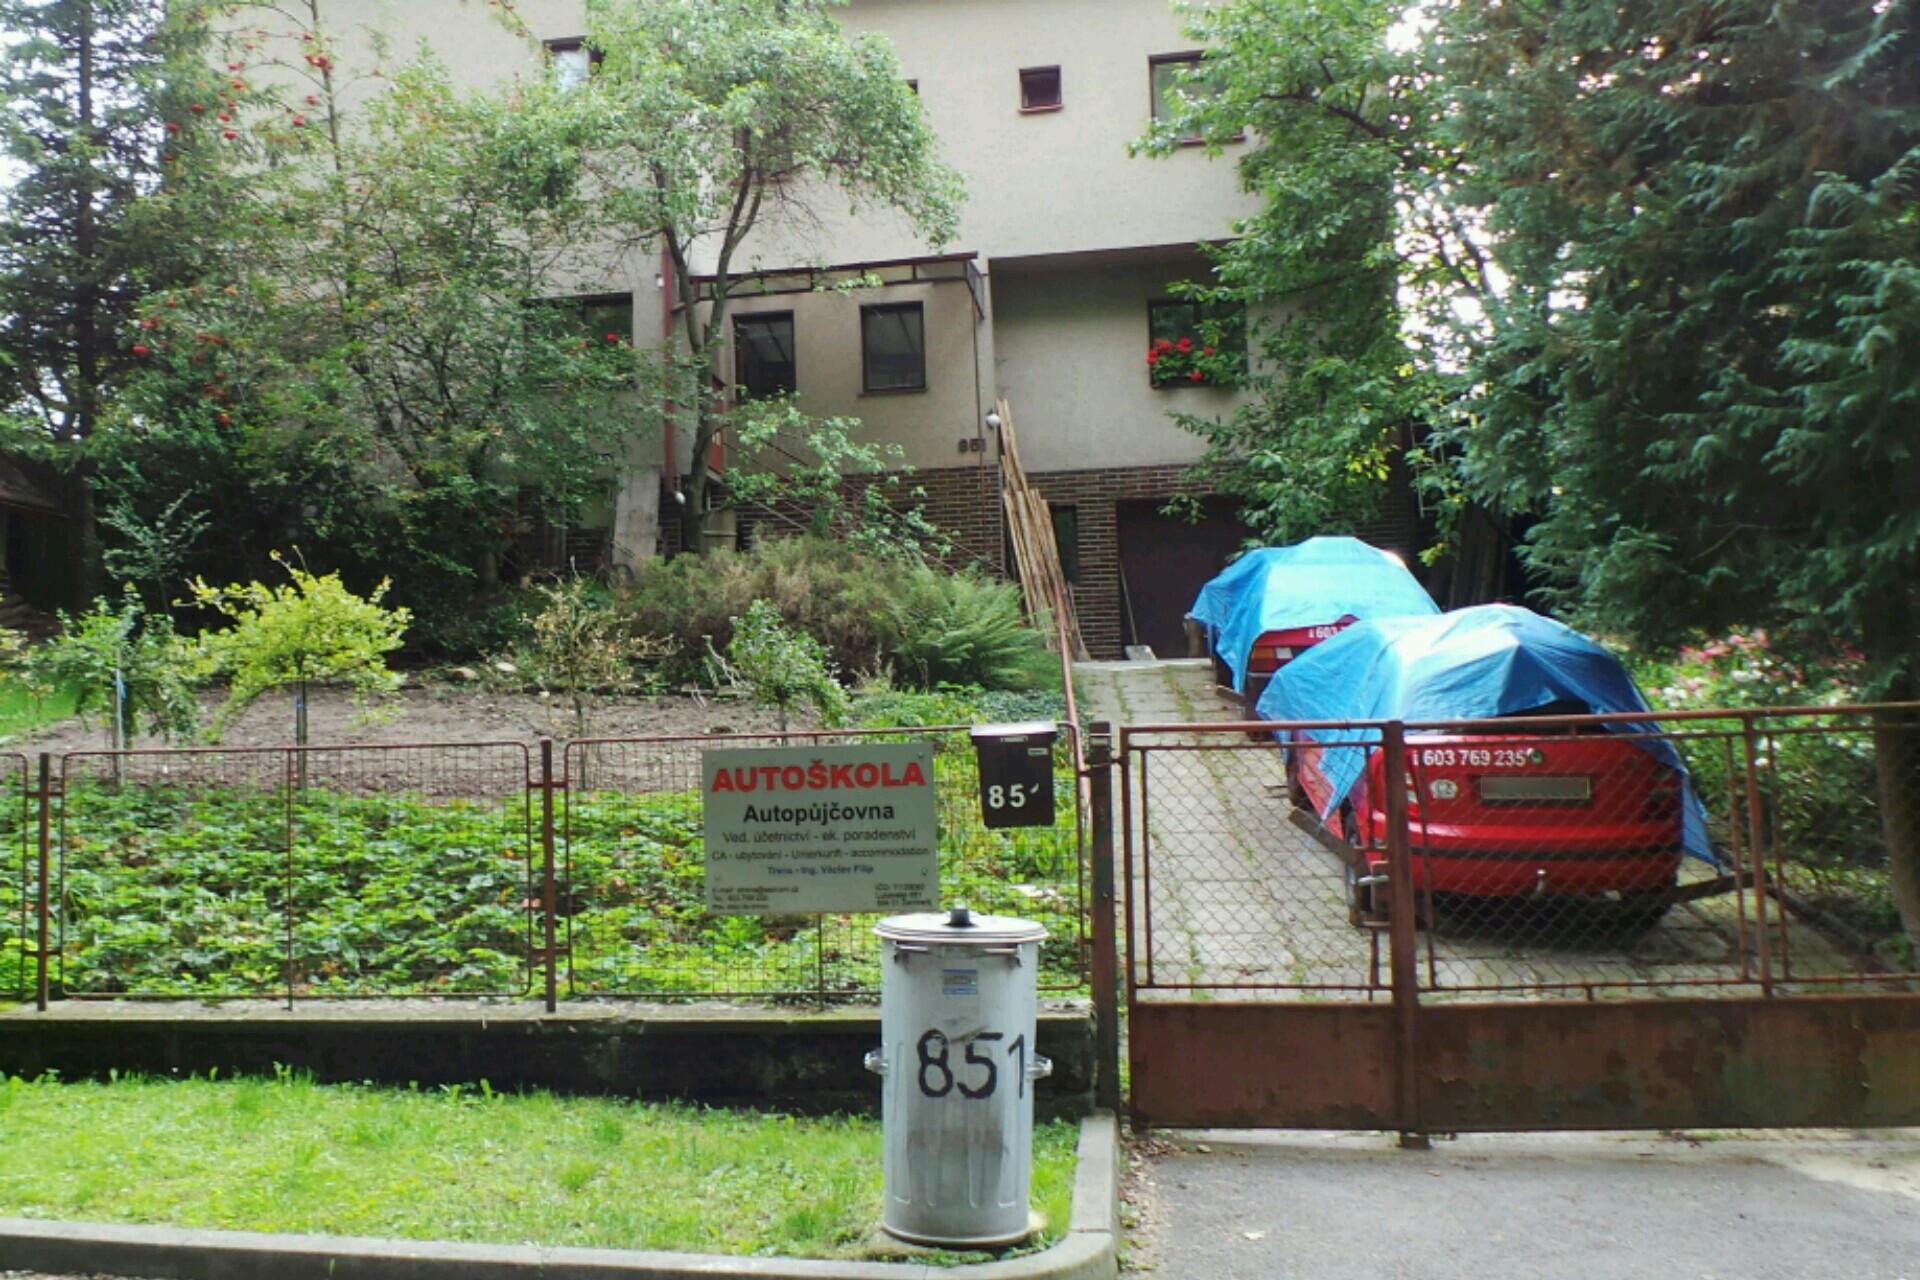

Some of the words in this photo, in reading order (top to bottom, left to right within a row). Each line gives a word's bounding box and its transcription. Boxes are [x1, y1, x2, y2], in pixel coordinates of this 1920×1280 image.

[1422, 749, 1456, 767] 603
[1458, 749, 1491, 767] 769
[1493, 749, 1527, 768] 235
[711, 759, 926, 793] AUTOŠKOLA
[743, 802, 895, 826] Autopůjčovna
[917, 1028, 1025, 1100] 851
